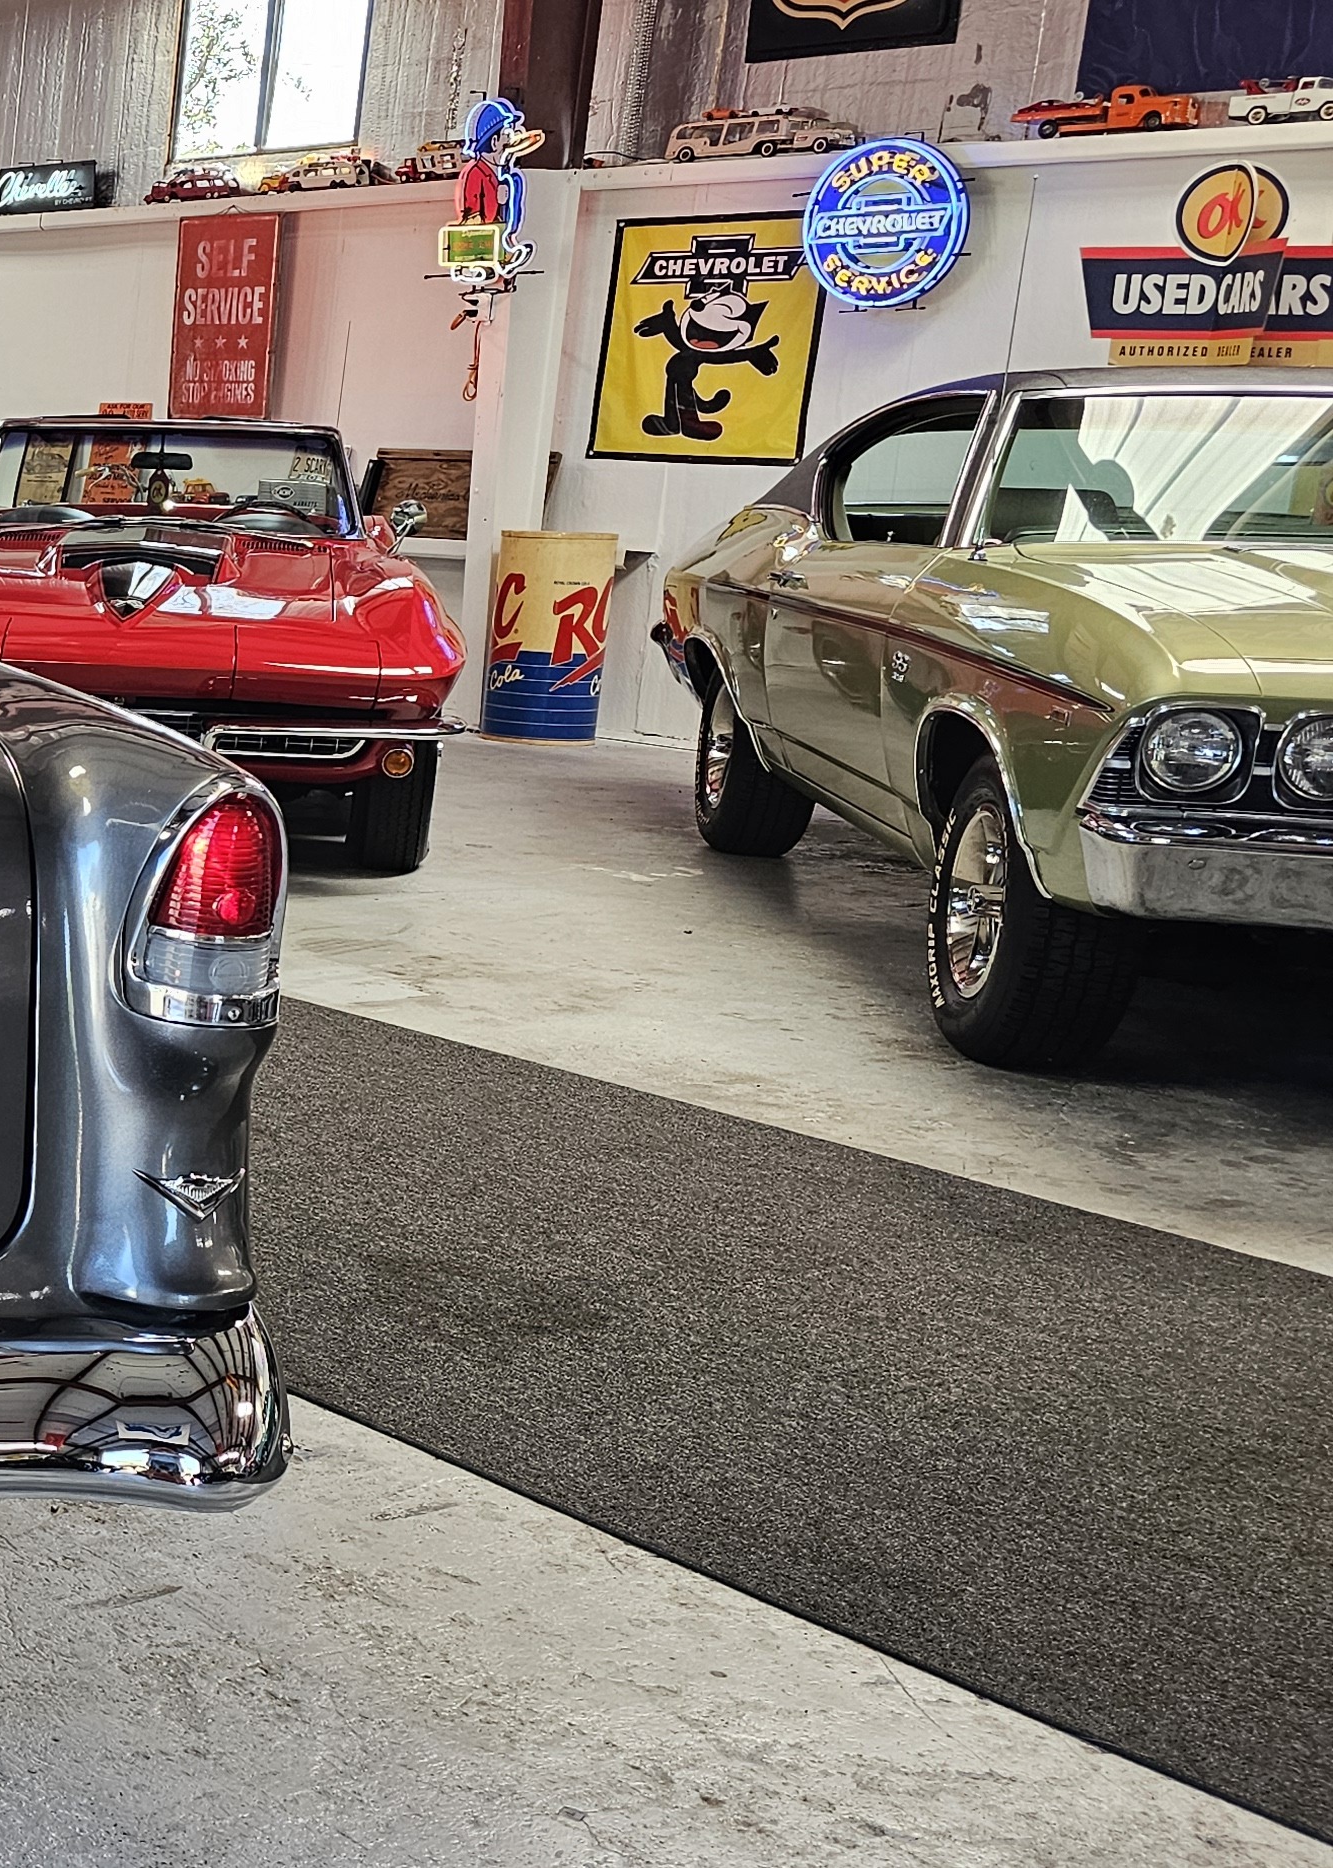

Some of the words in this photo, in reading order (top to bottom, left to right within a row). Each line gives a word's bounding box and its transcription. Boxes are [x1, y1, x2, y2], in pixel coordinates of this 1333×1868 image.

[831, 151, 940, 193] SUPER
[817, 210, 946, 237] CHEVROLET
[196, 238, 258, 279] SELF
[653, 256, 789, 276] CHEVROLET
[823, 249, 939, 296] SERVICE
[183, 286, 266, 326] SERVICE
[1111, 273, 1217, 315] USED
[1217, 269, 1265, 316] CARS
[185, 359, 200, 381] NO
[1119, 345, 1208, 358] AUTHORIZED
[1216, 344, 1241, 358] DEALER
[182, 383, 208, 403] STOP
[489, 665, 525, 690] Cola
[929, 807, 957, 914] CLASSIC
[926, 922, 946, 1010] MAXGRIP
